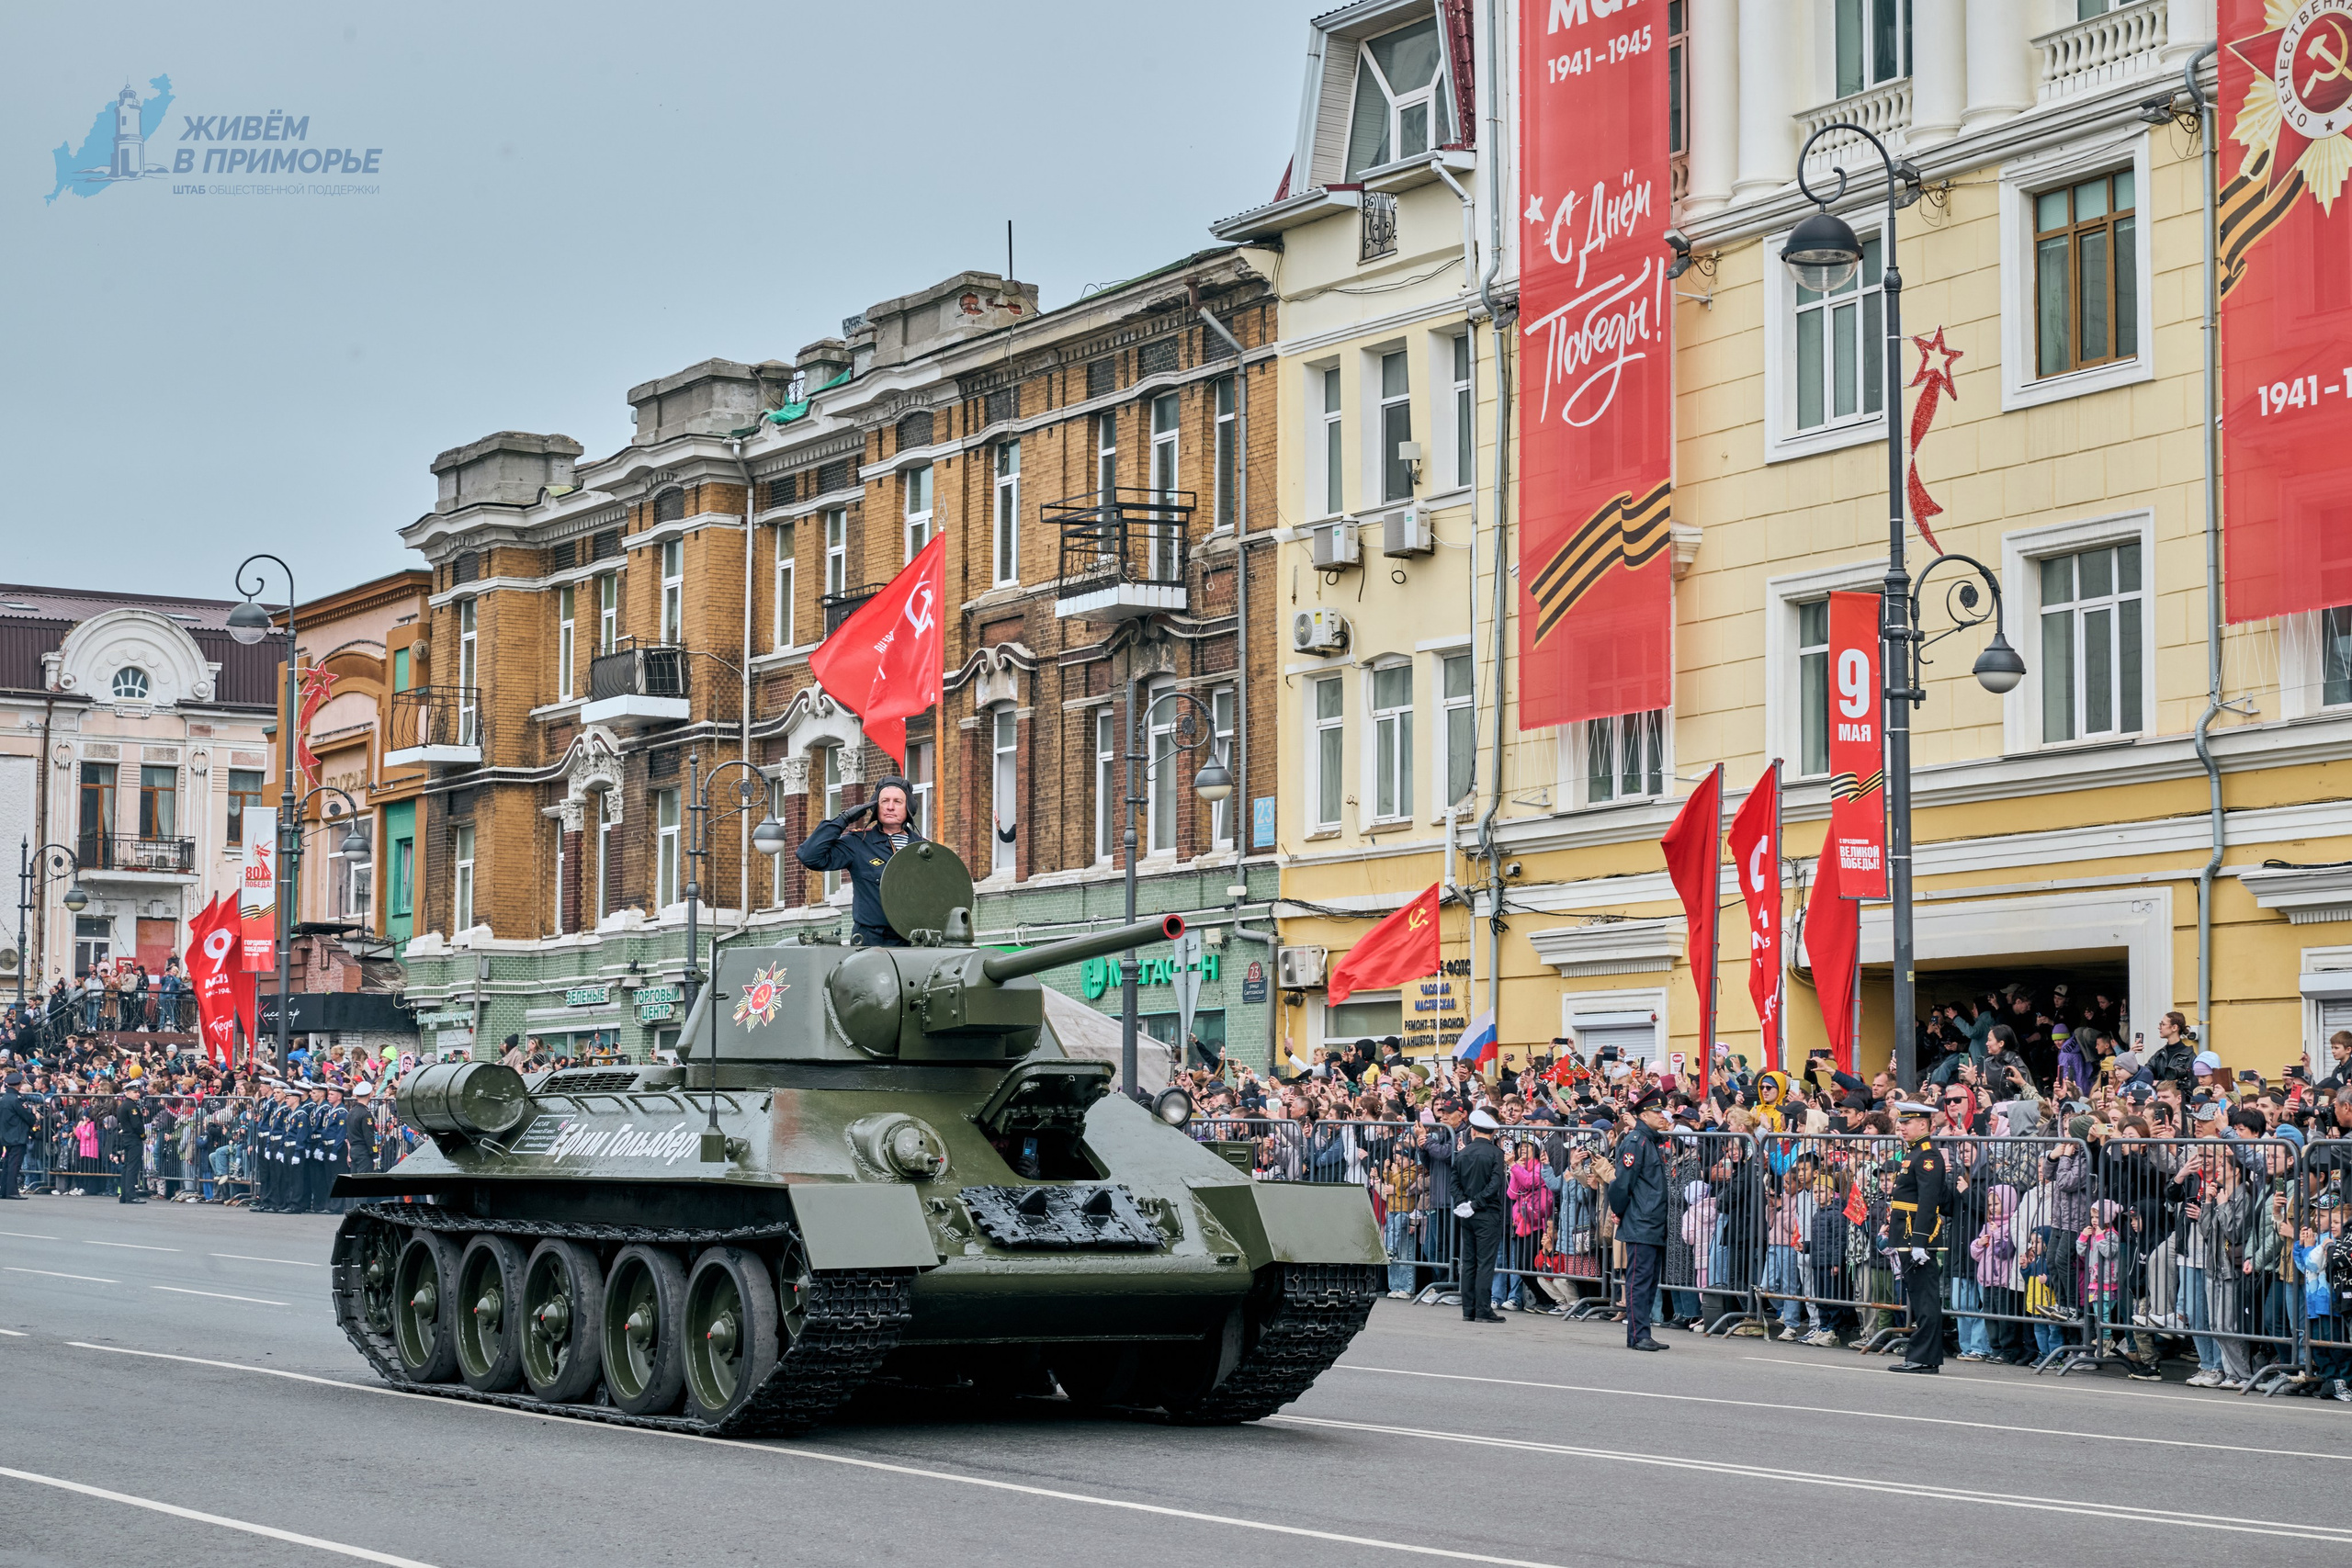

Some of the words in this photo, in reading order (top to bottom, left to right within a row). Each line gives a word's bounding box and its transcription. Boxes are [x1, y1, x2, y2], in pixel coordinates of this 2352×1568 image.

[1547, 24, 1652, 84] 1941-1945
[1544, 188, 1577, 265] С
[1575, 168, 1652, 288] Днём
[1524, 256, 1665, 427] Победы!
[1838, 648, 1870, 718] 9
[1838, 723, 1871, 742] МАЯ
[1256, 799, 1272, 824] 23
[1839, 845, 1880, 858] ВЕЛИКОЙ
[1840, 857, 1880, 871] ПОБЕДЫ!
[244, 880, 273, 888] ПОБЕДА!
[203, 927, 232, 974] 9
[1250, 965, 1260, 979] 23
[566, 987, 605, 1006] ЗЕЛЕНЫЕ
[633, 987, 680, 1005] ТОРГОВЫЙ
[1419, 982, 1451, 996] ЧАСОАЯ
[641, 1004, 671, 1022] ЦЕНТР
[1404, 1019, 1428, 1031] РЕМОНТ
[545, 1122, 611, 1164] Ефим
[599, 1122, 701, 1166] Гольдберг
